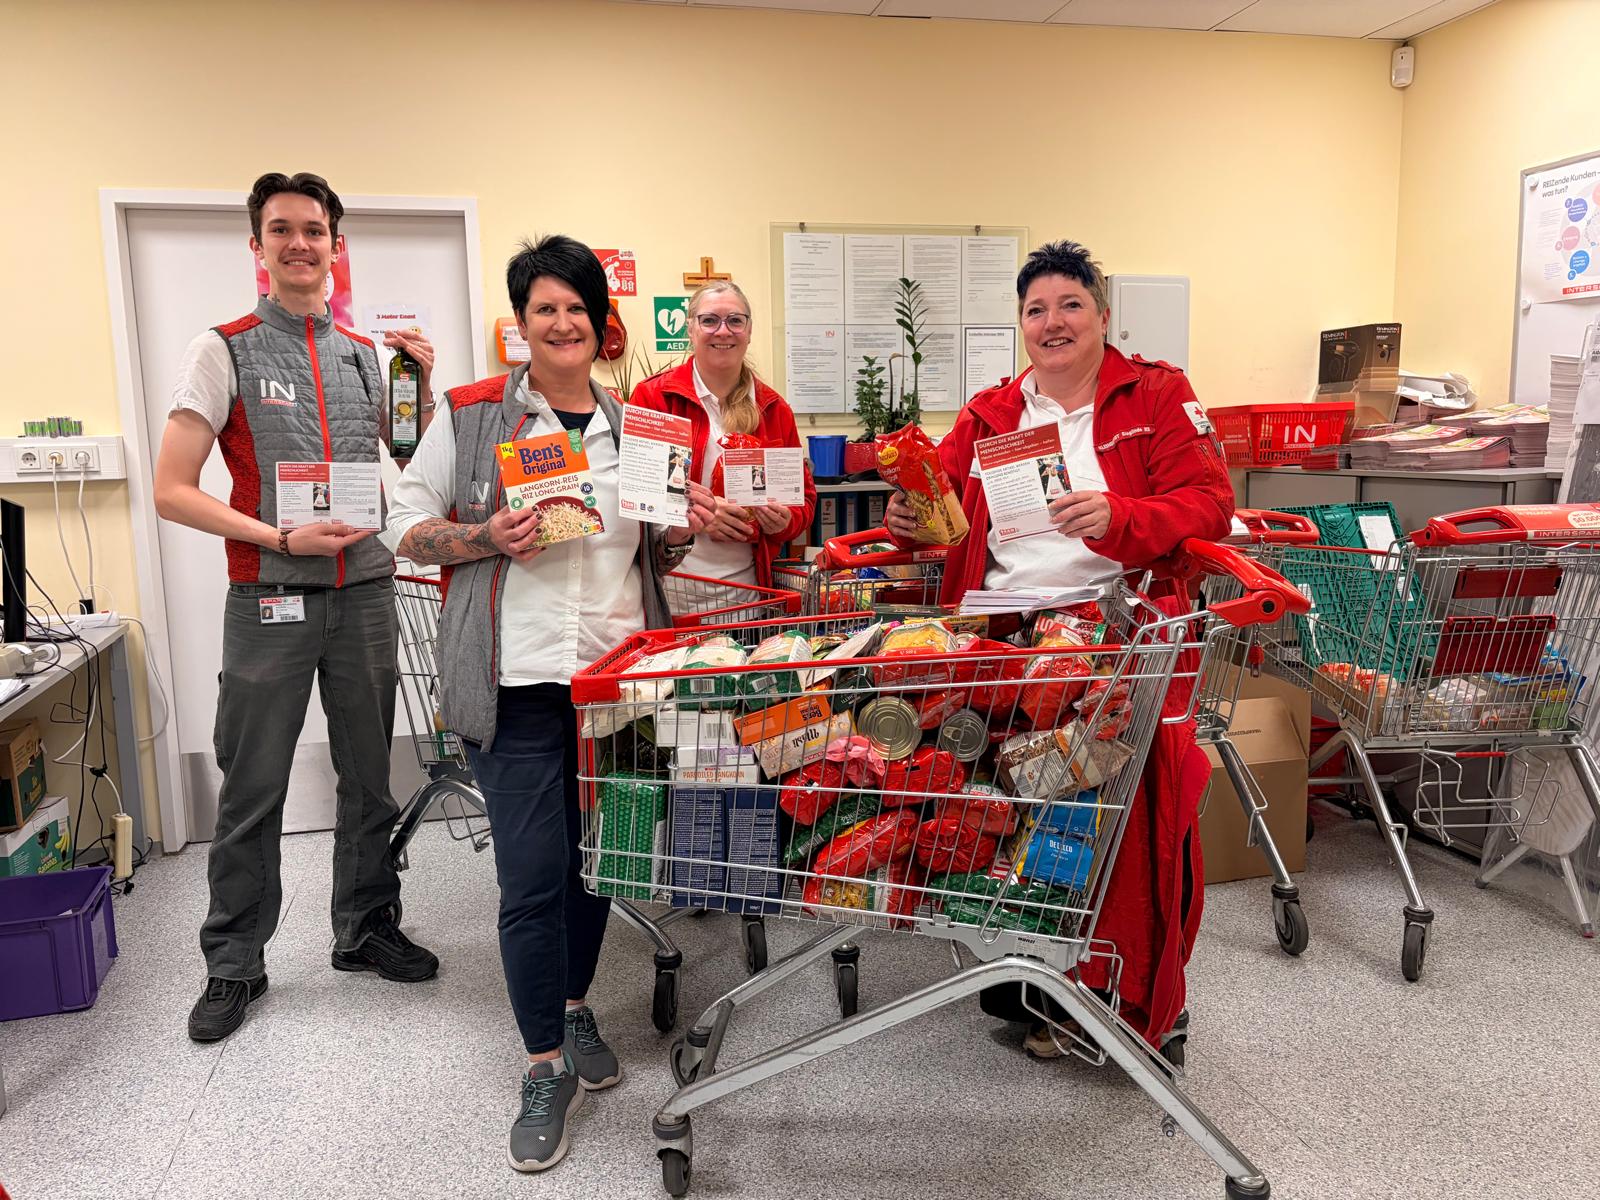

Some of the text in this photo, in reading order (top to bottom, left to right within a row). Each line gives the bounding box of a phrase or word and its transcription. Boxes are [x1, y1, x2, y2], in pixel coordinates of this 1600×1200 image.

[1542, 176, 1570, 189] REIZende
[1571, 171, 1597, 181] Kunden
[1542, 185, 1569, 198] was tun?
[1566, 284, 1600, 293] INTERS
[666, 342, 685, 350] AED
[260, 378, 296, 401] IN
[651, 413, 665, 421] KRAFT
[979, 441, 998, 449] DURCH
[1007, 433, 1024, 442] KRAFT
[1024, 430, 1035, 438] DER
[1283, 424, 1317, 444] IN
[501, 445, 513, 454] 1kg
[518, 443, 564, 465] Ben's
[980, 439, 1025, 455] MENSCHLICHKEIT
[523, 457, 567, 475] Original
[519, 474, 579, 494] LANGKORN-REIS
[521, 482, 580, 500] RIZ LONG GRAIN
